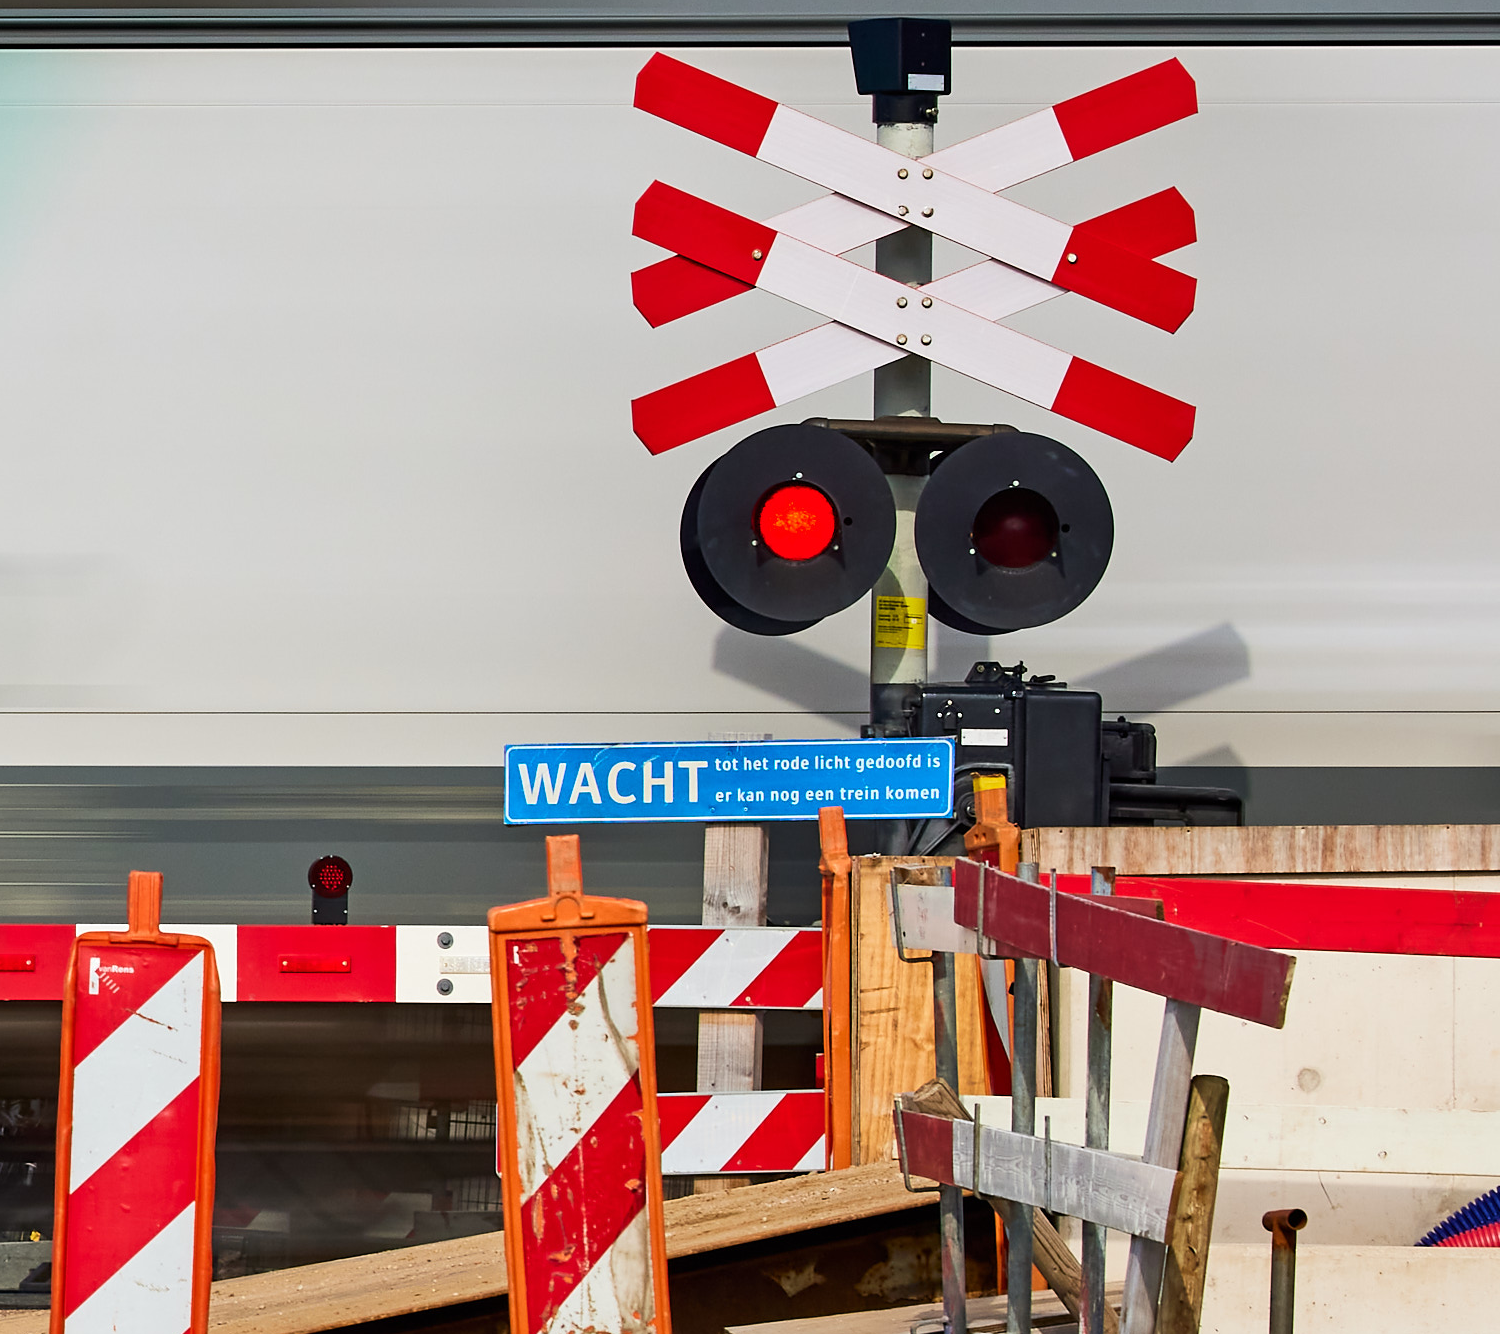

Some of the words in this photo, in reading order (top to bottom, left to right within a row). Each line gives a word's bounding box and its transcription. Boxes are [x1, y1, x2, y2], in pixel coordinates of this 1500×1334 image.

[715, 758, 739, 772] tot
[743, 757, 769, 771] het
[774, 756, 810, 771] rode
[814, 755, 850, 770] licht
[855, 754, 922, 773] gedoofd
[927, 754, 941, 769] is
[518, 760, 708, 805] WACHT
[715, 791, 731, 803] er
[737, 788, 764, 802] kan
[770, 790, 799, 805] nog
[805, 790, 834, 801] een
[840, 786, 880, 801] trein
[885, 786, 940, 800] komen
